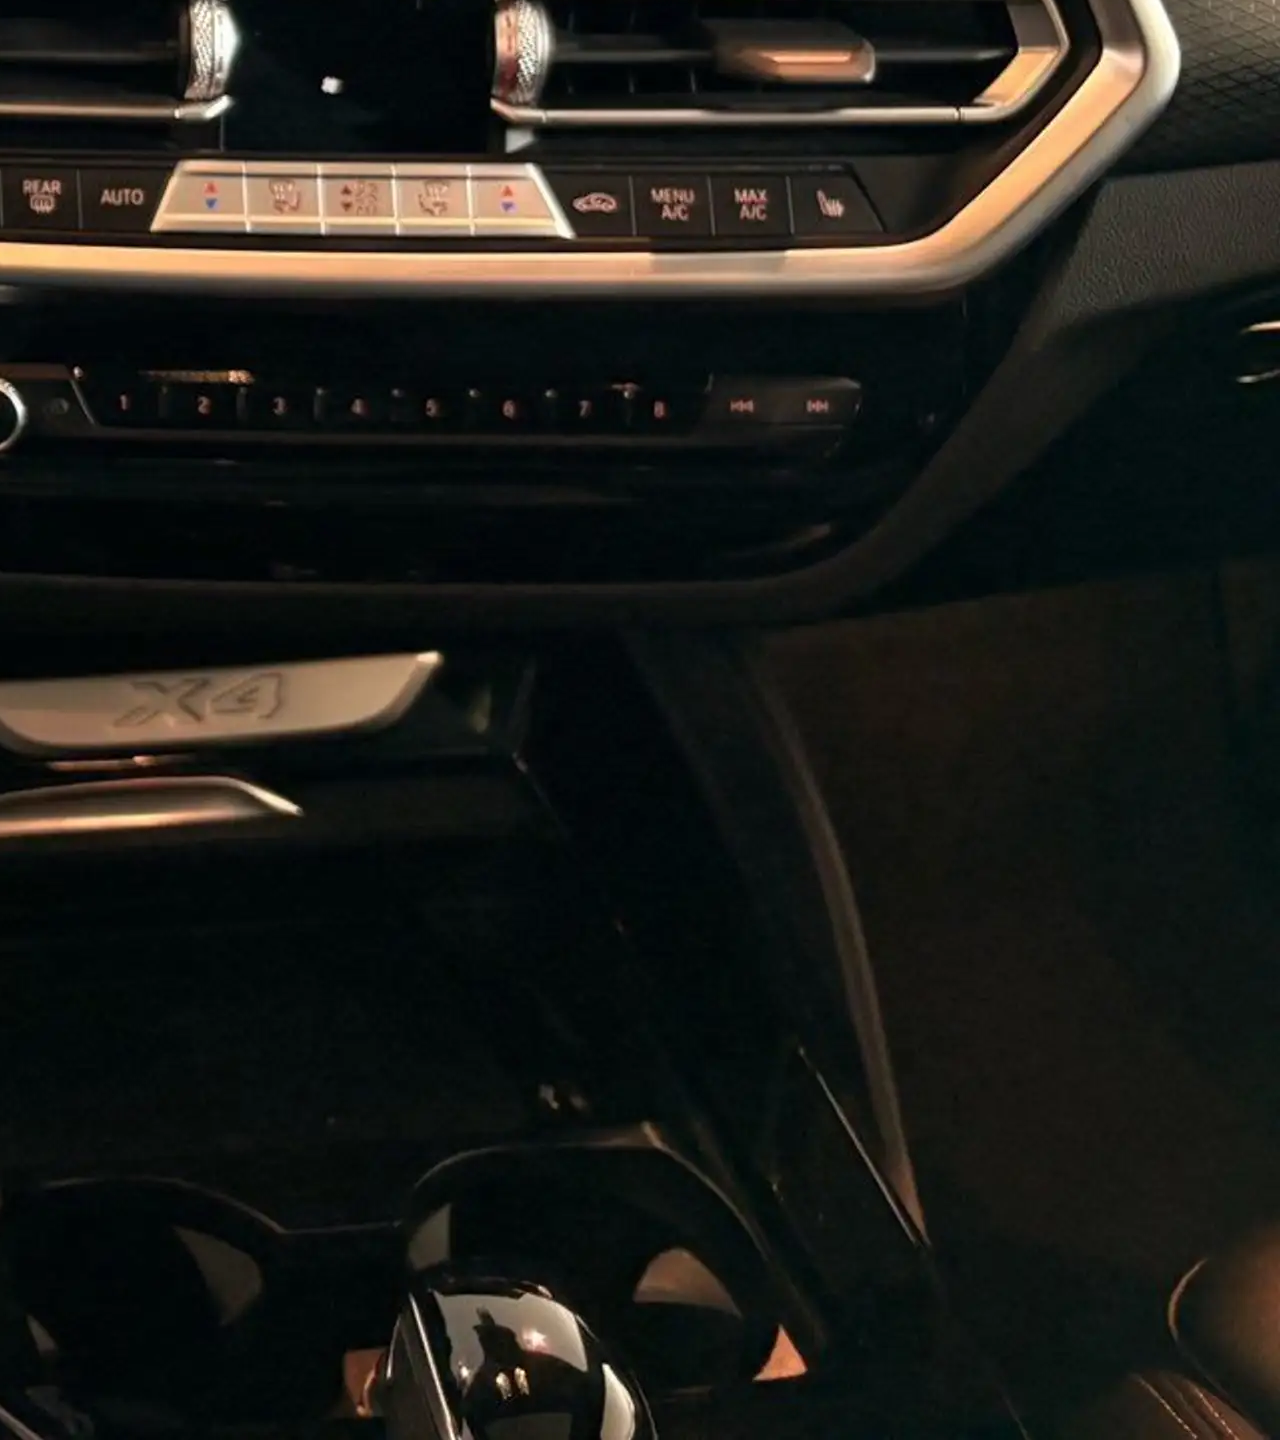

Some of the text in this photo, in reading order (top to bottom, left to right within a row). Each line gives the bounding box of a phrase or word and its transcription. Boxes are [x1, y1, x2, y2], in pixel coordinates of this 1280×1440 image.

[22, 179, 62, 195] REAR
[650, 187, 696, 204] MENU
[733, 187, 768, 204] MAX
[100, 188, 144, 206] AUTO
[661, 203, 689, 221] A/C
[739, 203, 767, 221] A/C
[196, 394, 210, 416] 2
[272, 395, 287, 416] 3
[111, 671, 284, 729] X4
